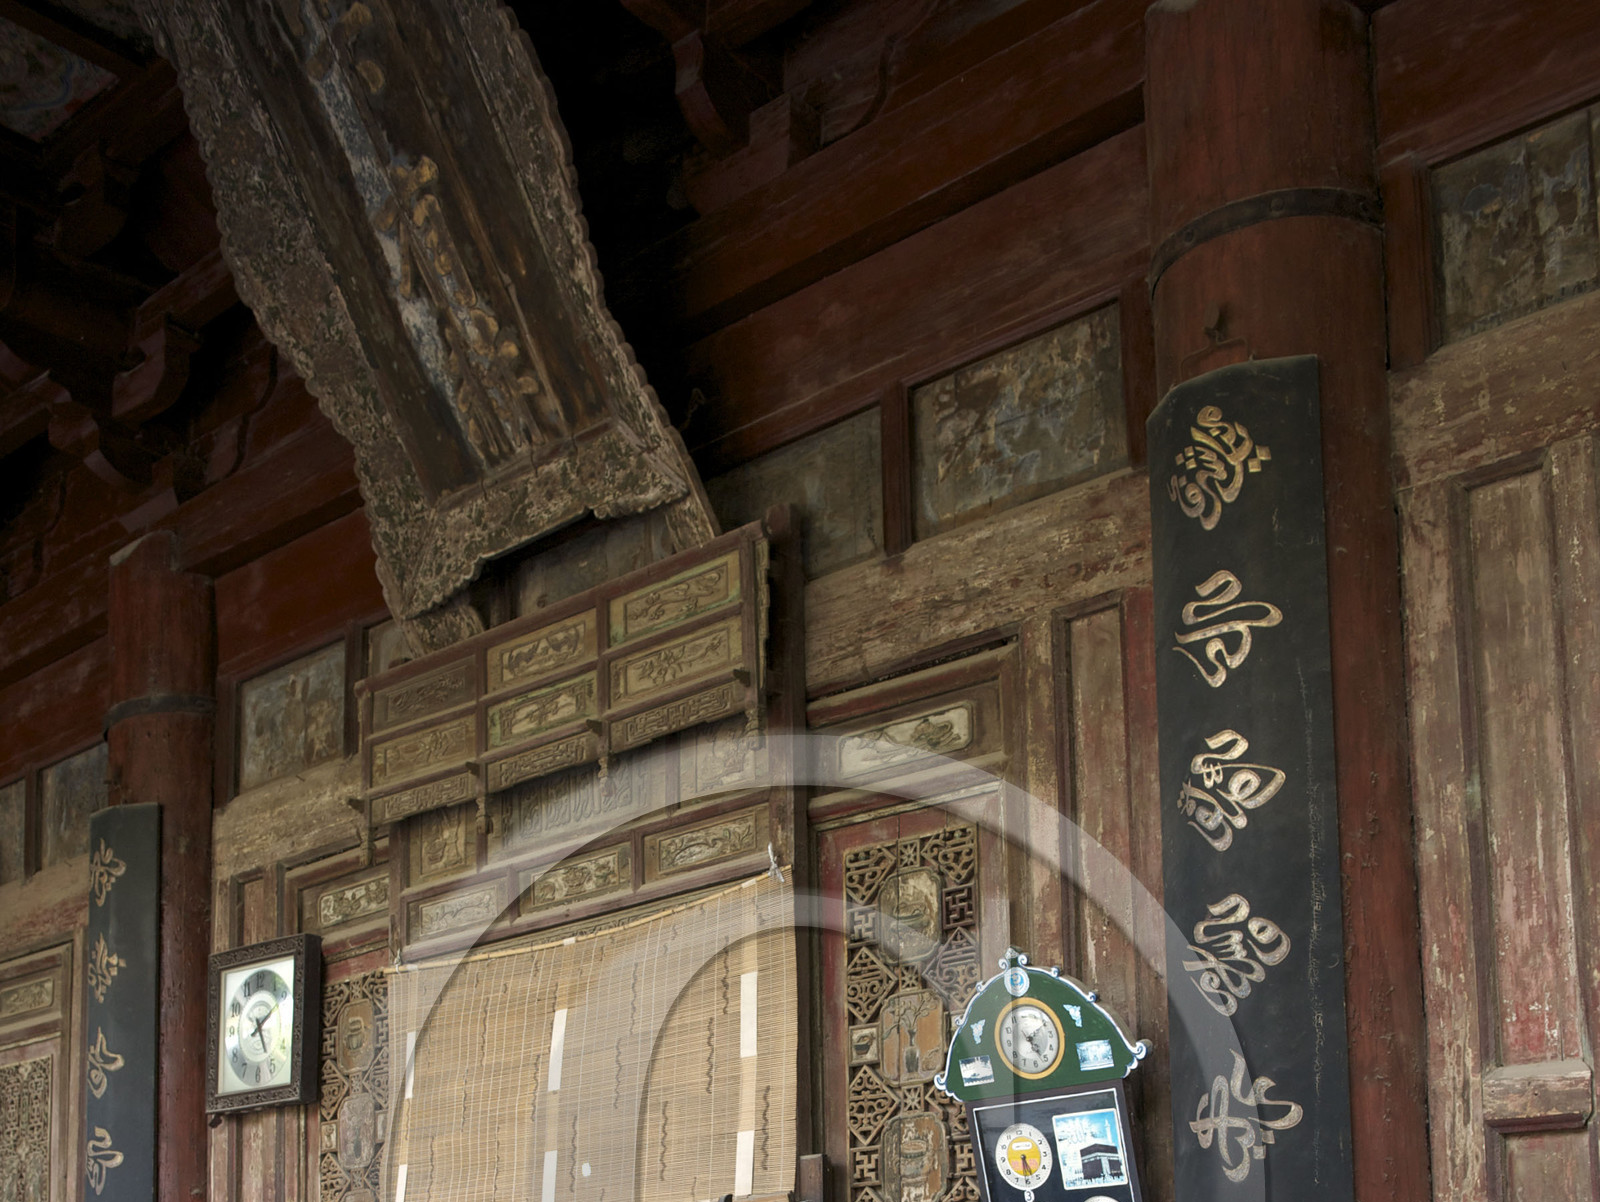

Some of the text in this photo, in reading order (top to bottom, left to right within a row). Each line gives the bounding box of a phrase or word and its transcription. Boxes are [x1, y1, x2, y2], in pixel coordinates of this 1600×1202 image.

[256, 972, 265, 988] 12
[244, 981, 250, 997] 11
[231, 1002, 241, 1017] 10
[229, 1026, 234, 1037] 9
[232, 1048, 238, 1063] 8
[242, 1063, 247, 1078] 7
[270, 1059, 275, 1074] 5
[255, 1067, 261, 1083] 6
[1026, 1191, 1032, 1201] 3
